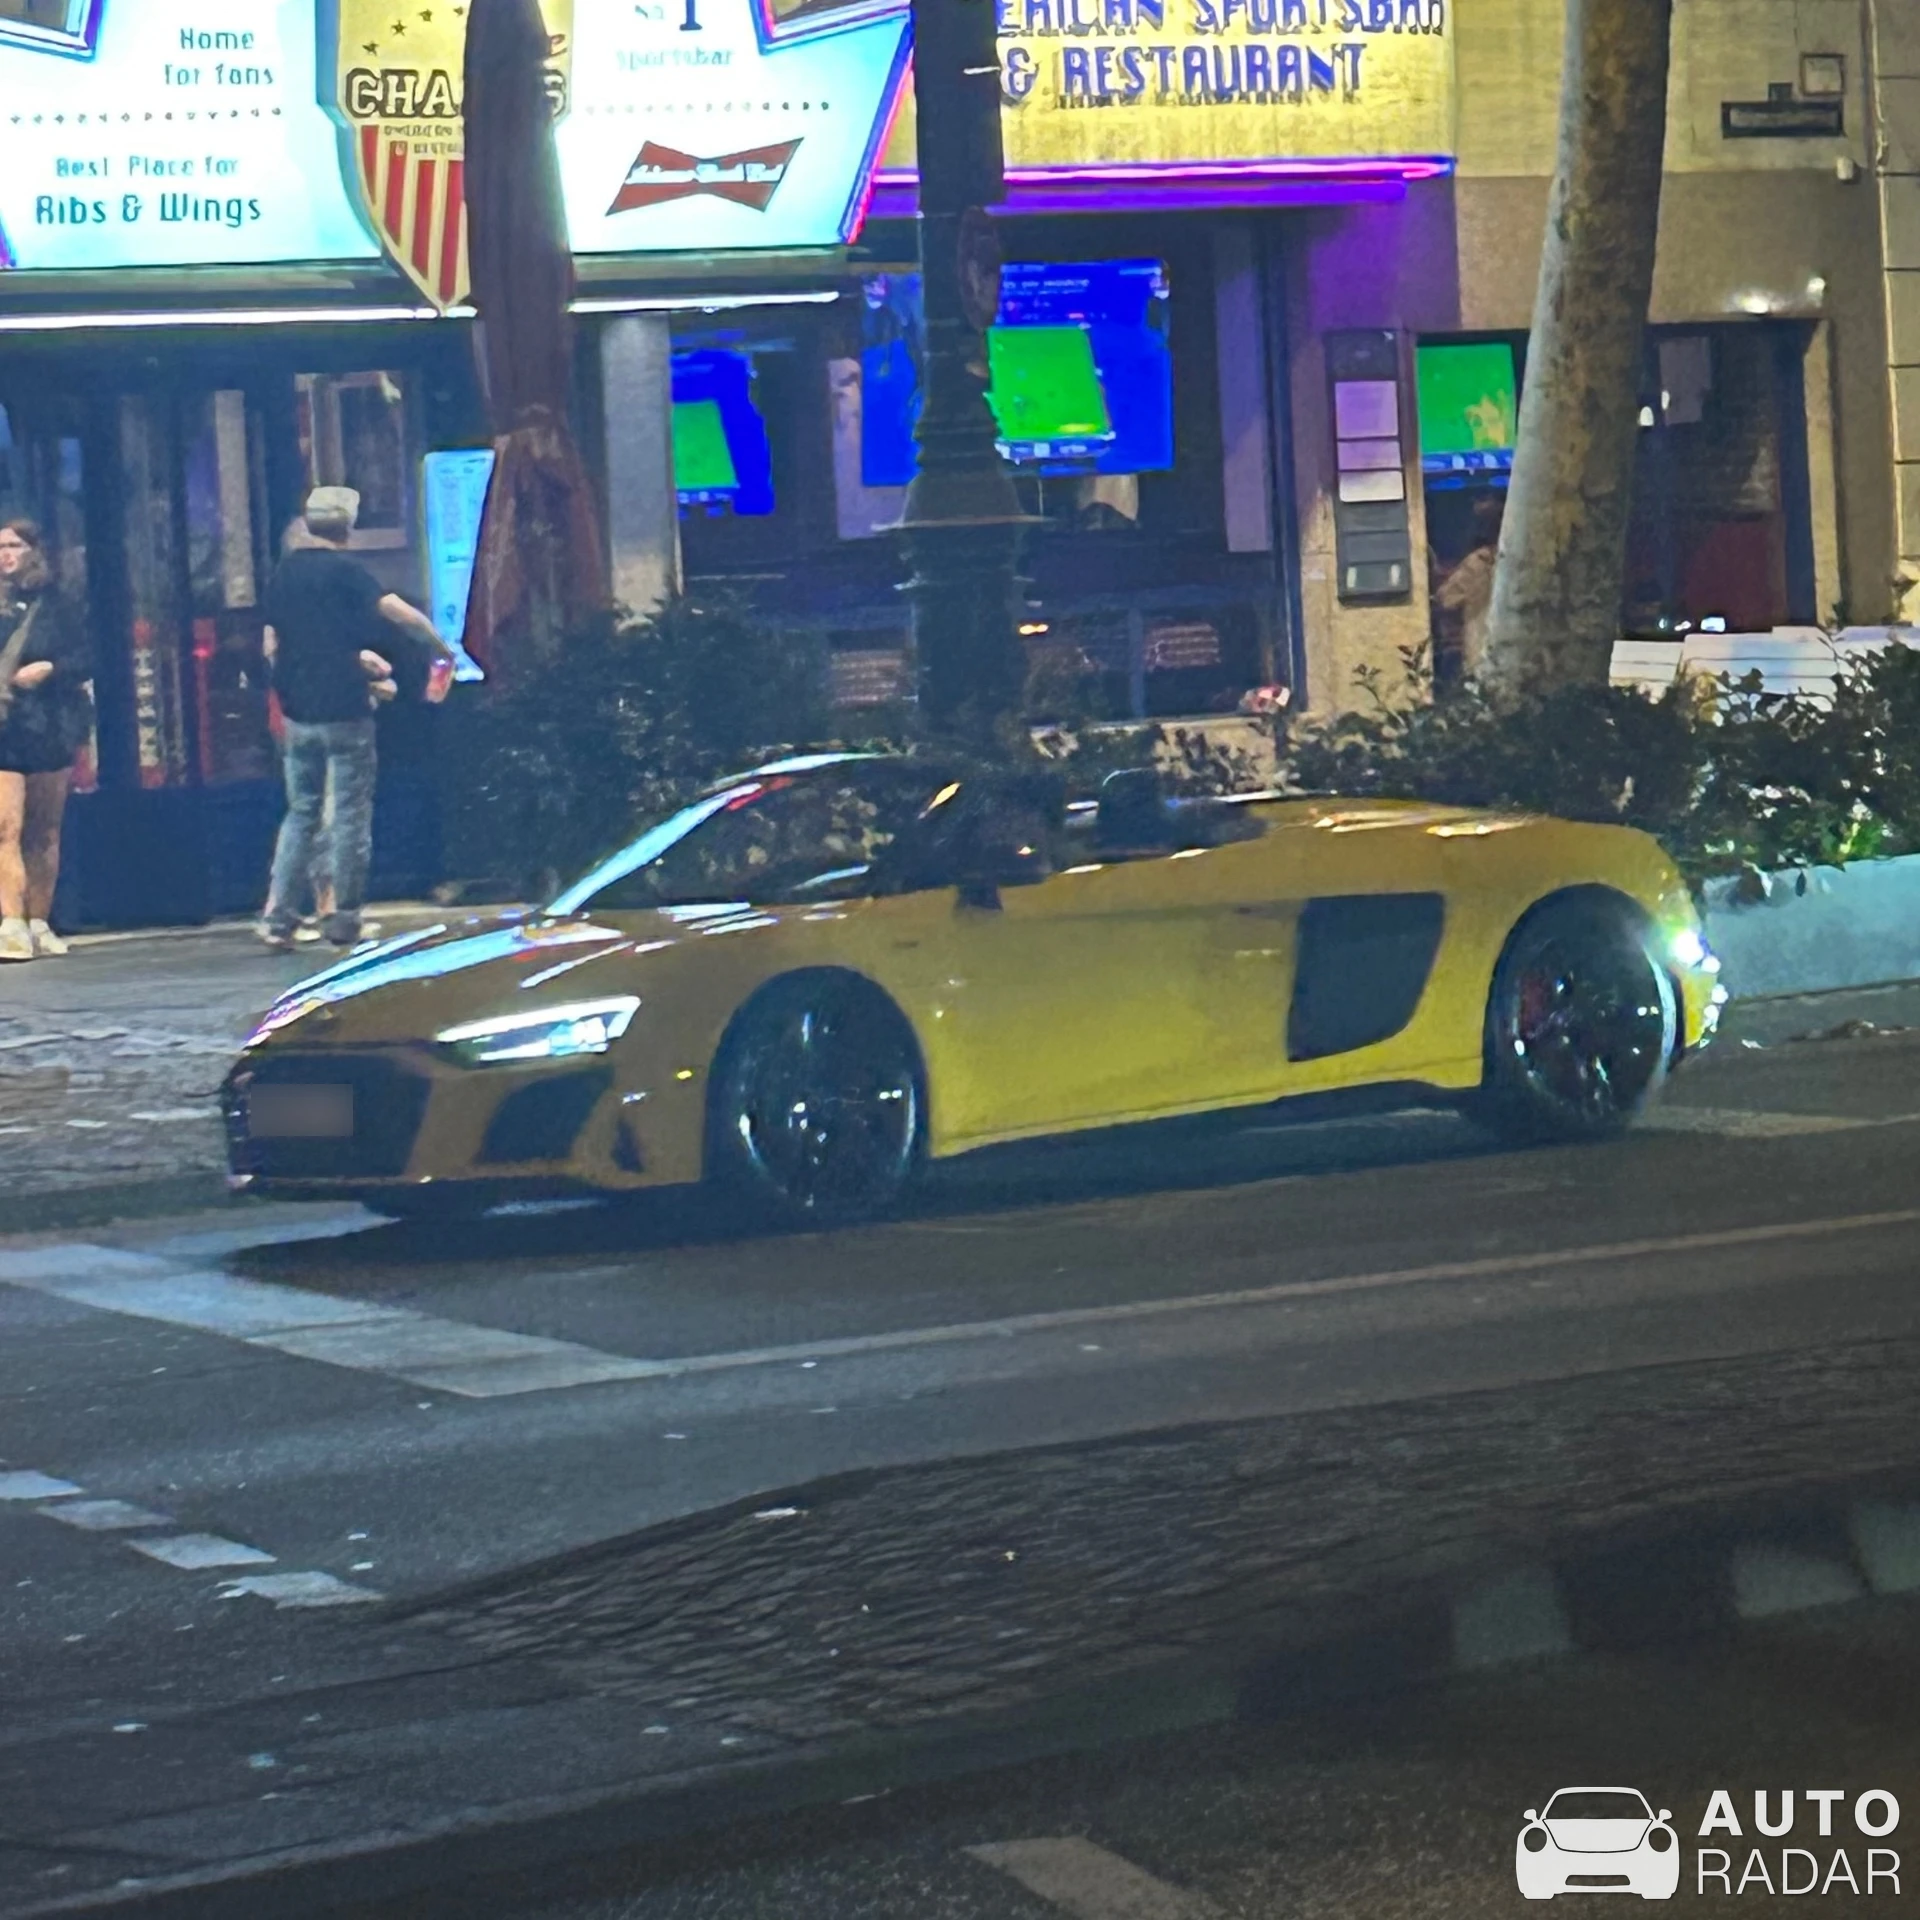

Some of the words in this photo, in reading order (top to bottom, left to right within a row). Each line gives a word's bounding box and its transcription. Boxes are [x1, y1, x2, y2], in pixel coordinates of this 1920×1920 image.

[993, 0, 1164, 36] ERICAN
[180, 28, 254, 50] Home
[215, 63, 274, 85] fans
[1004, 46, 1039, 102] &
[1058, 44, 1367, 106] RESTAURANT
[129, 155, 195, 178] Place
[36, 194, 106, 225] Ribs
[122, 193, 142, 223] &
[160, 192, 262, 229] Wings
